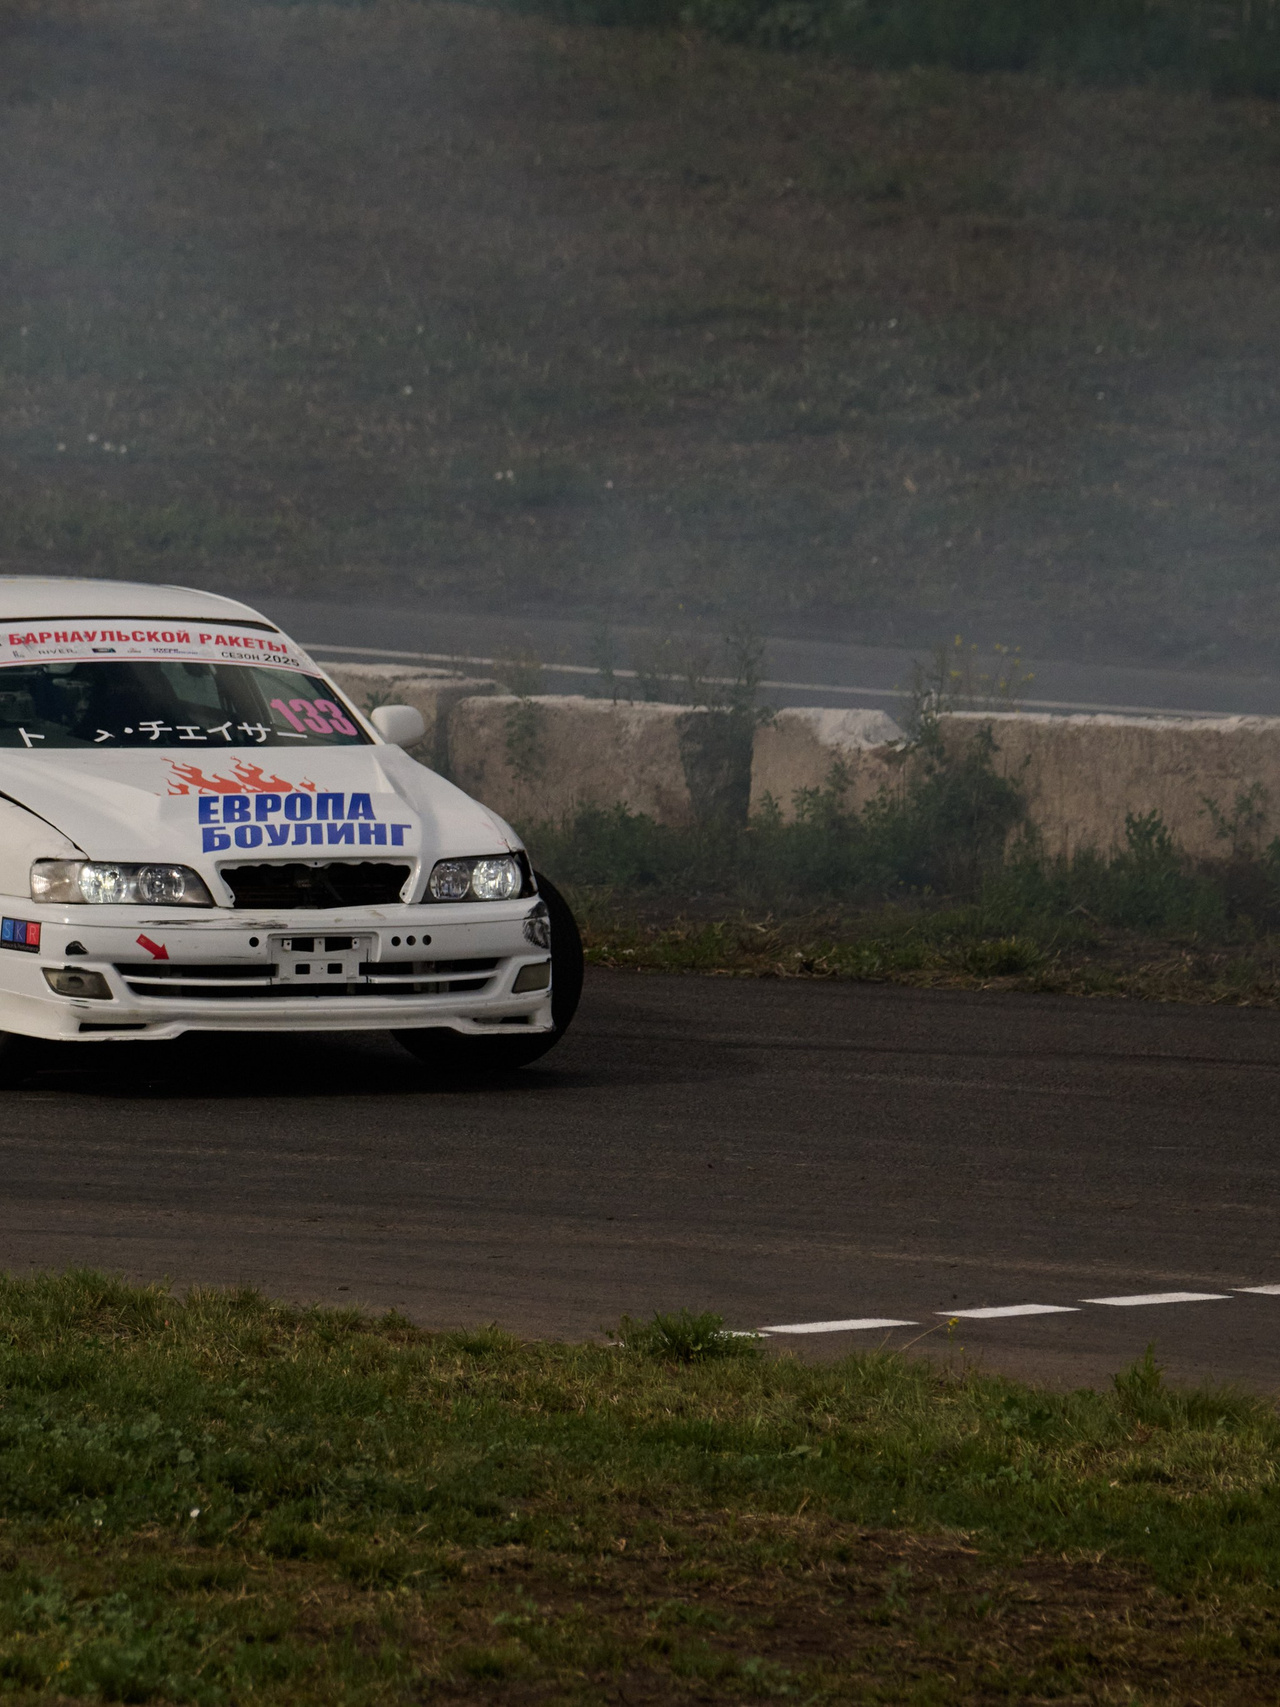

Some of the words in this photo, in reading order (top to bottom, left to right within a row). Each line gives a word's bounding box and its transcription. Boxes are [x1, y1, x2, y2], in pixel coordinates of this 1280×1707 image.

[8, 629, 191, 646] БАРНАУЛЬСКОЙ
[199, 633, 288, 654] РАКЕТЫ
[221, 651, 260, 661] СЕЗОН
[263, 653, 300, 667] 2025
[271, 698, 358, 736] 133
[198, 792, 376, 825] ЕВРОПА
[202, 822, 412, 854] БОУЛИНГ
[3, 921, 38, 942] SKR
